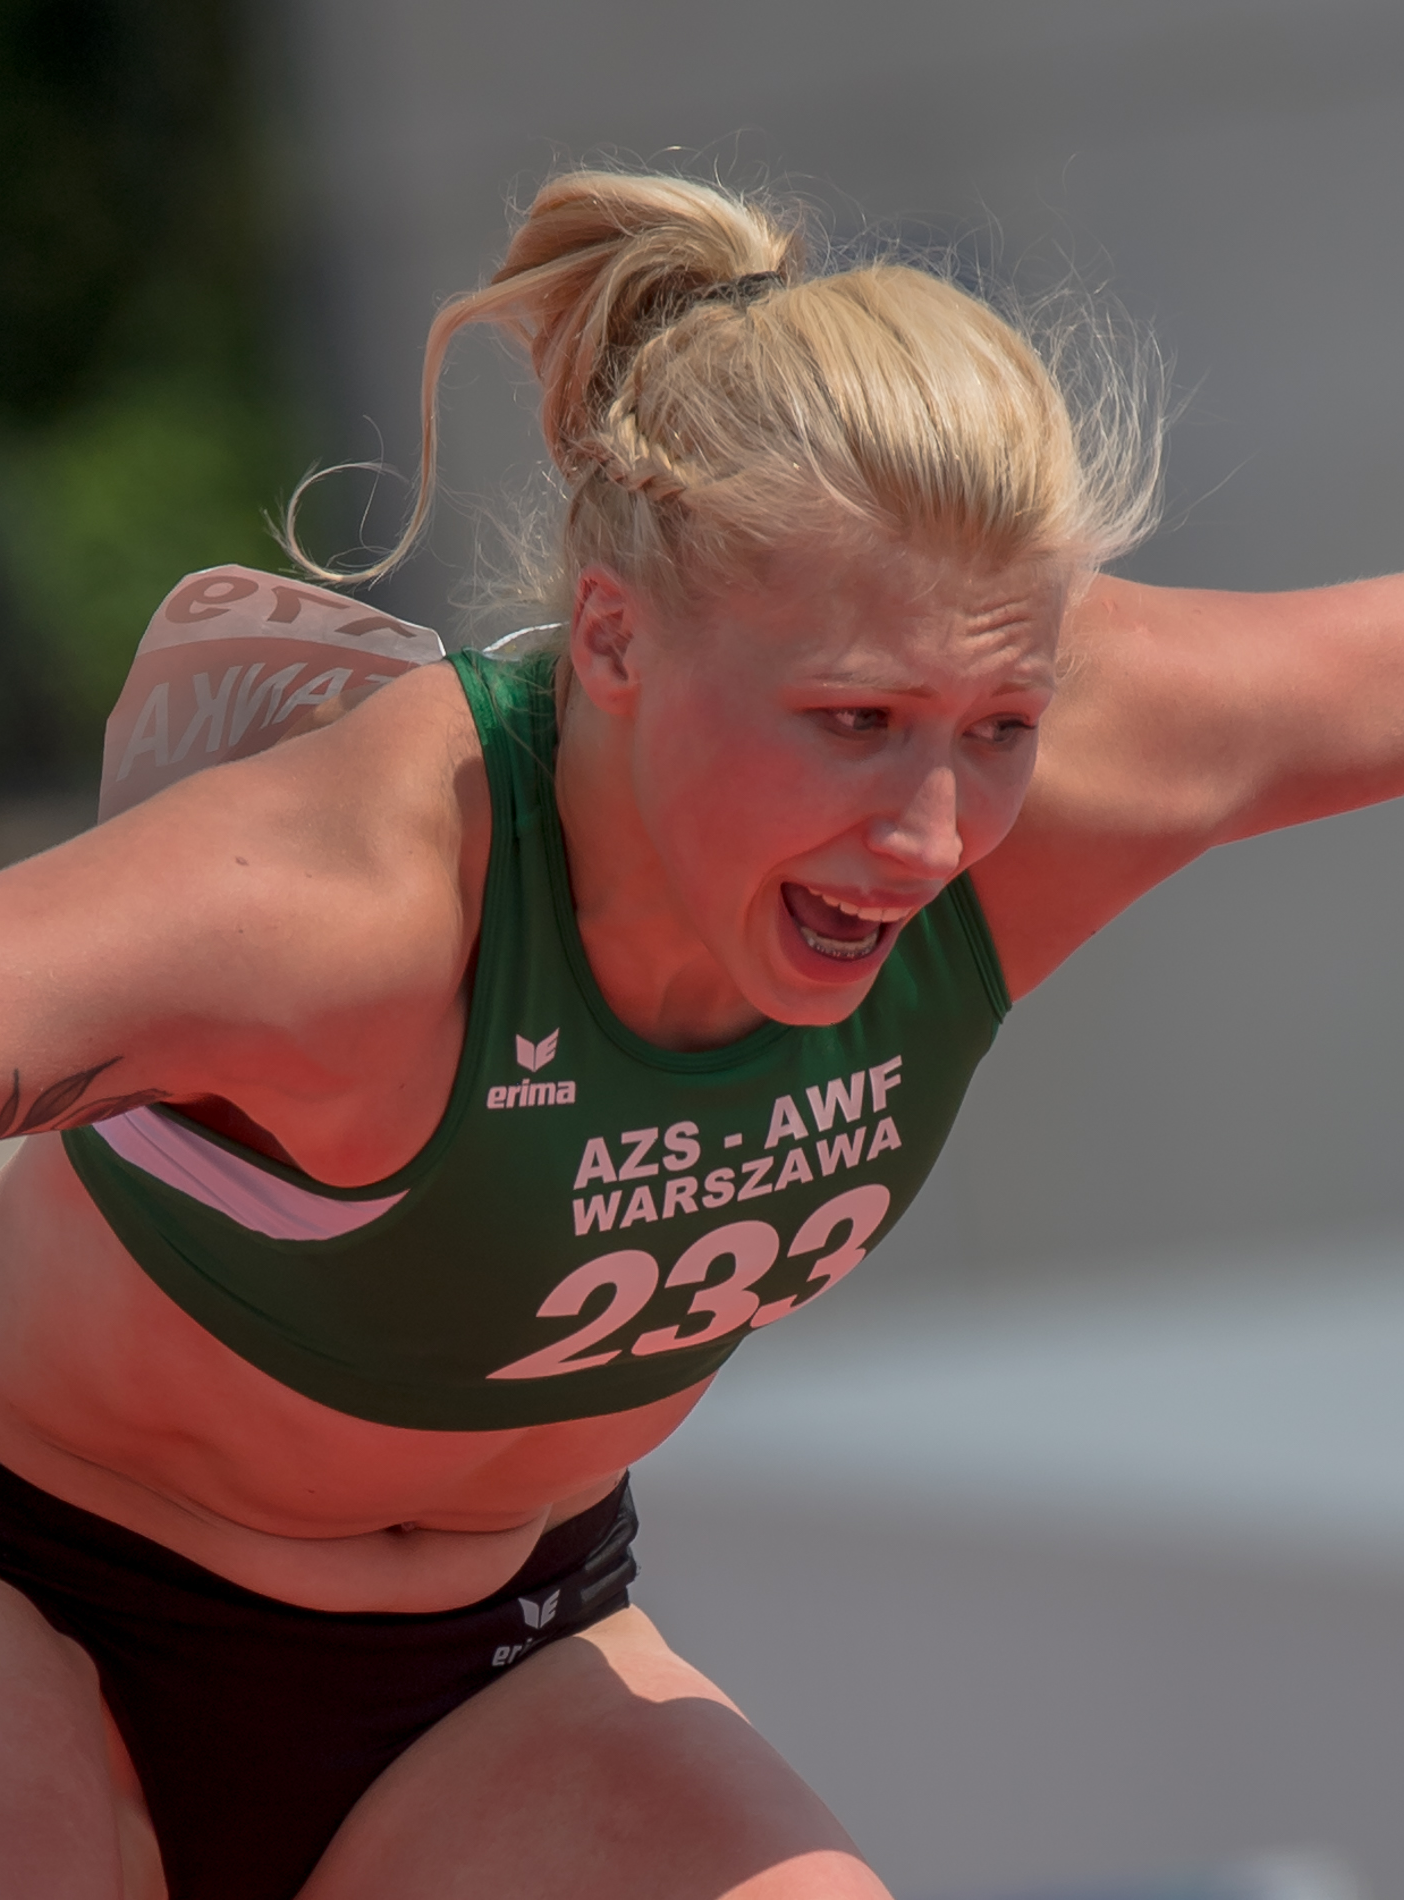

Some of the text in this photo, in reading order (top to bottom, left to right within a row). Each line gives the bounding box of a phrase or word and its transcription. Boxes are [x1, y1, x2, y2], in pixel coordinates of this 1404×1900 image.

[486, 1078, 577, 1110] erima
[572, 1055, 903, 1190] AZS - AWF
[571, 1116, 903, 1237] WARSZAWA
[484, 1183, 892, 1380] 233
